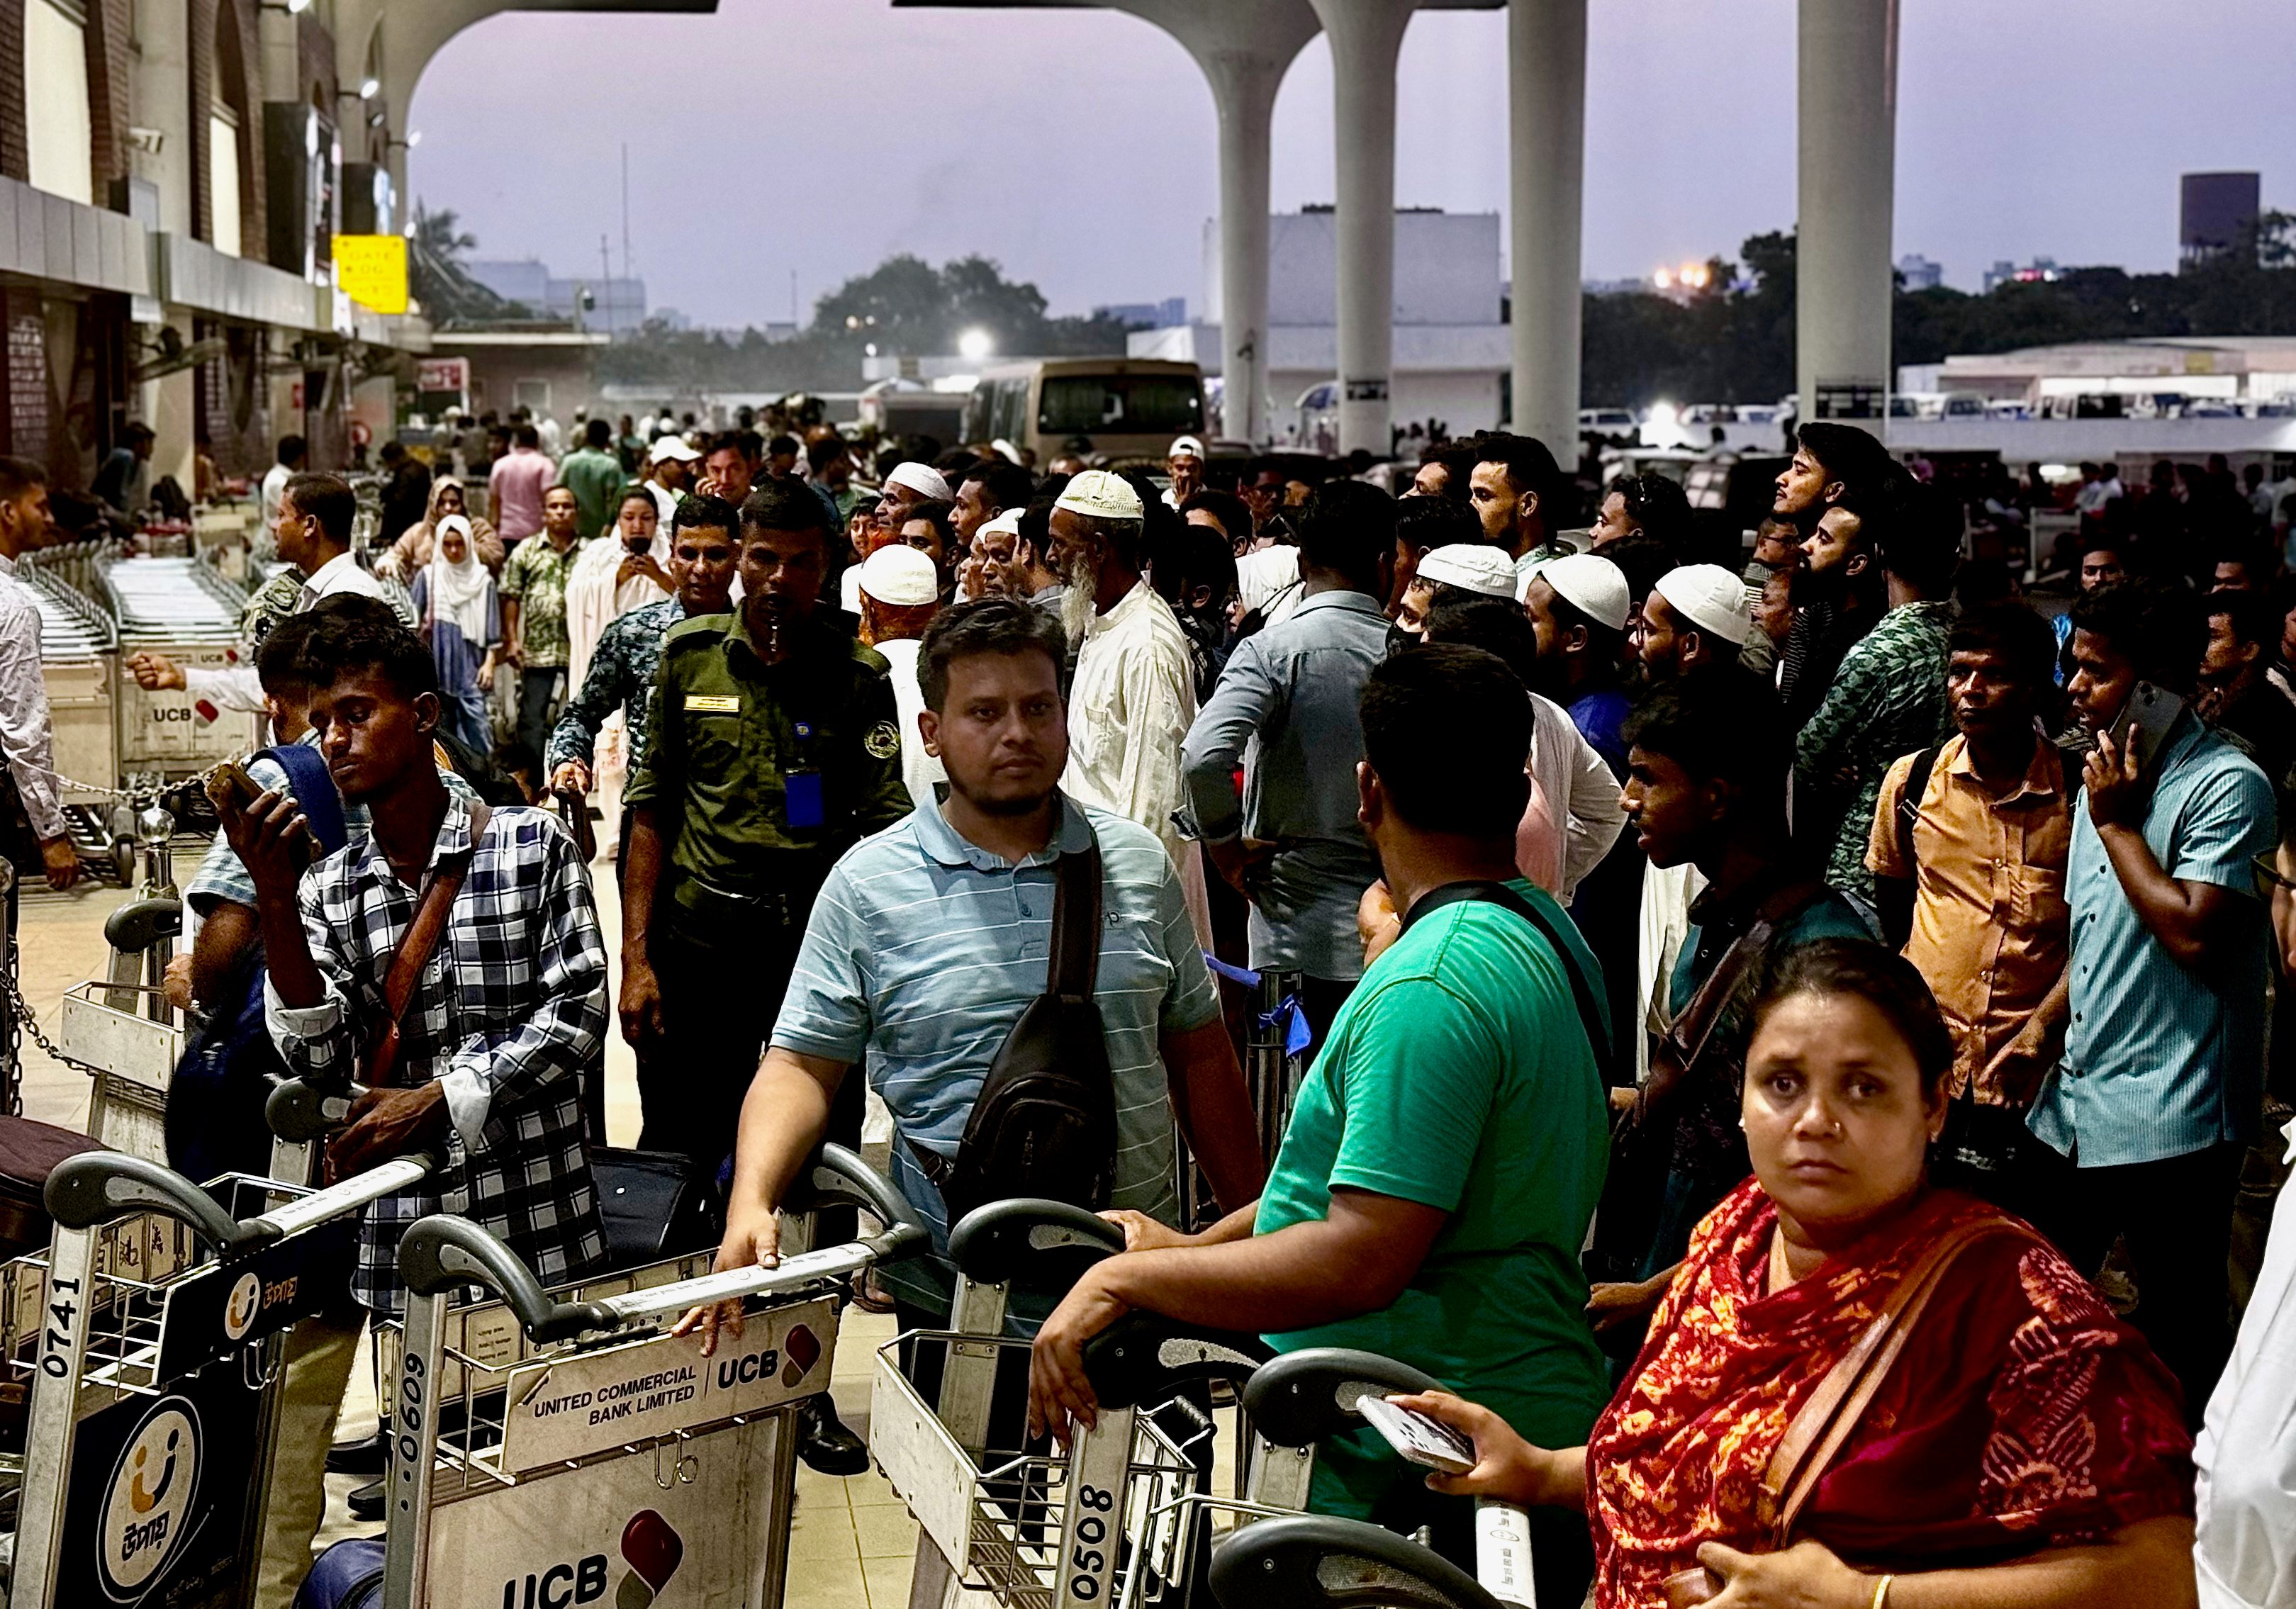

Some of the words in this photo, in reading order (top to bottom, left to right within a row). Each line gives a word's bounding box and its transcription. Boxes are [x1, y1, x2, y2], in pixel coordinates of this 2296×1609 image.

[201, 654, 223, 663] UCB
[154, 708, 191, 722] UCB
[263, 1276, 298, 1309] উপায়
[42, 1278, 79, 1378] 0741
[534, 1391, 593, 1418] UNITED
[597, 1365, 697, 1403] COMMERCIAL
[717, 1350, 778, 1389] UCB
[399, 1352, 425, 1463] 0609
[589, 1401, 632, 1425] BANK
[637, 1385, 695, 1413] LIMITED
[121, 1510, 170, 1562] উপায়
[1070, 1484, 1114, 1600] 0508
[503, 1554, 608, 1609] UCB
